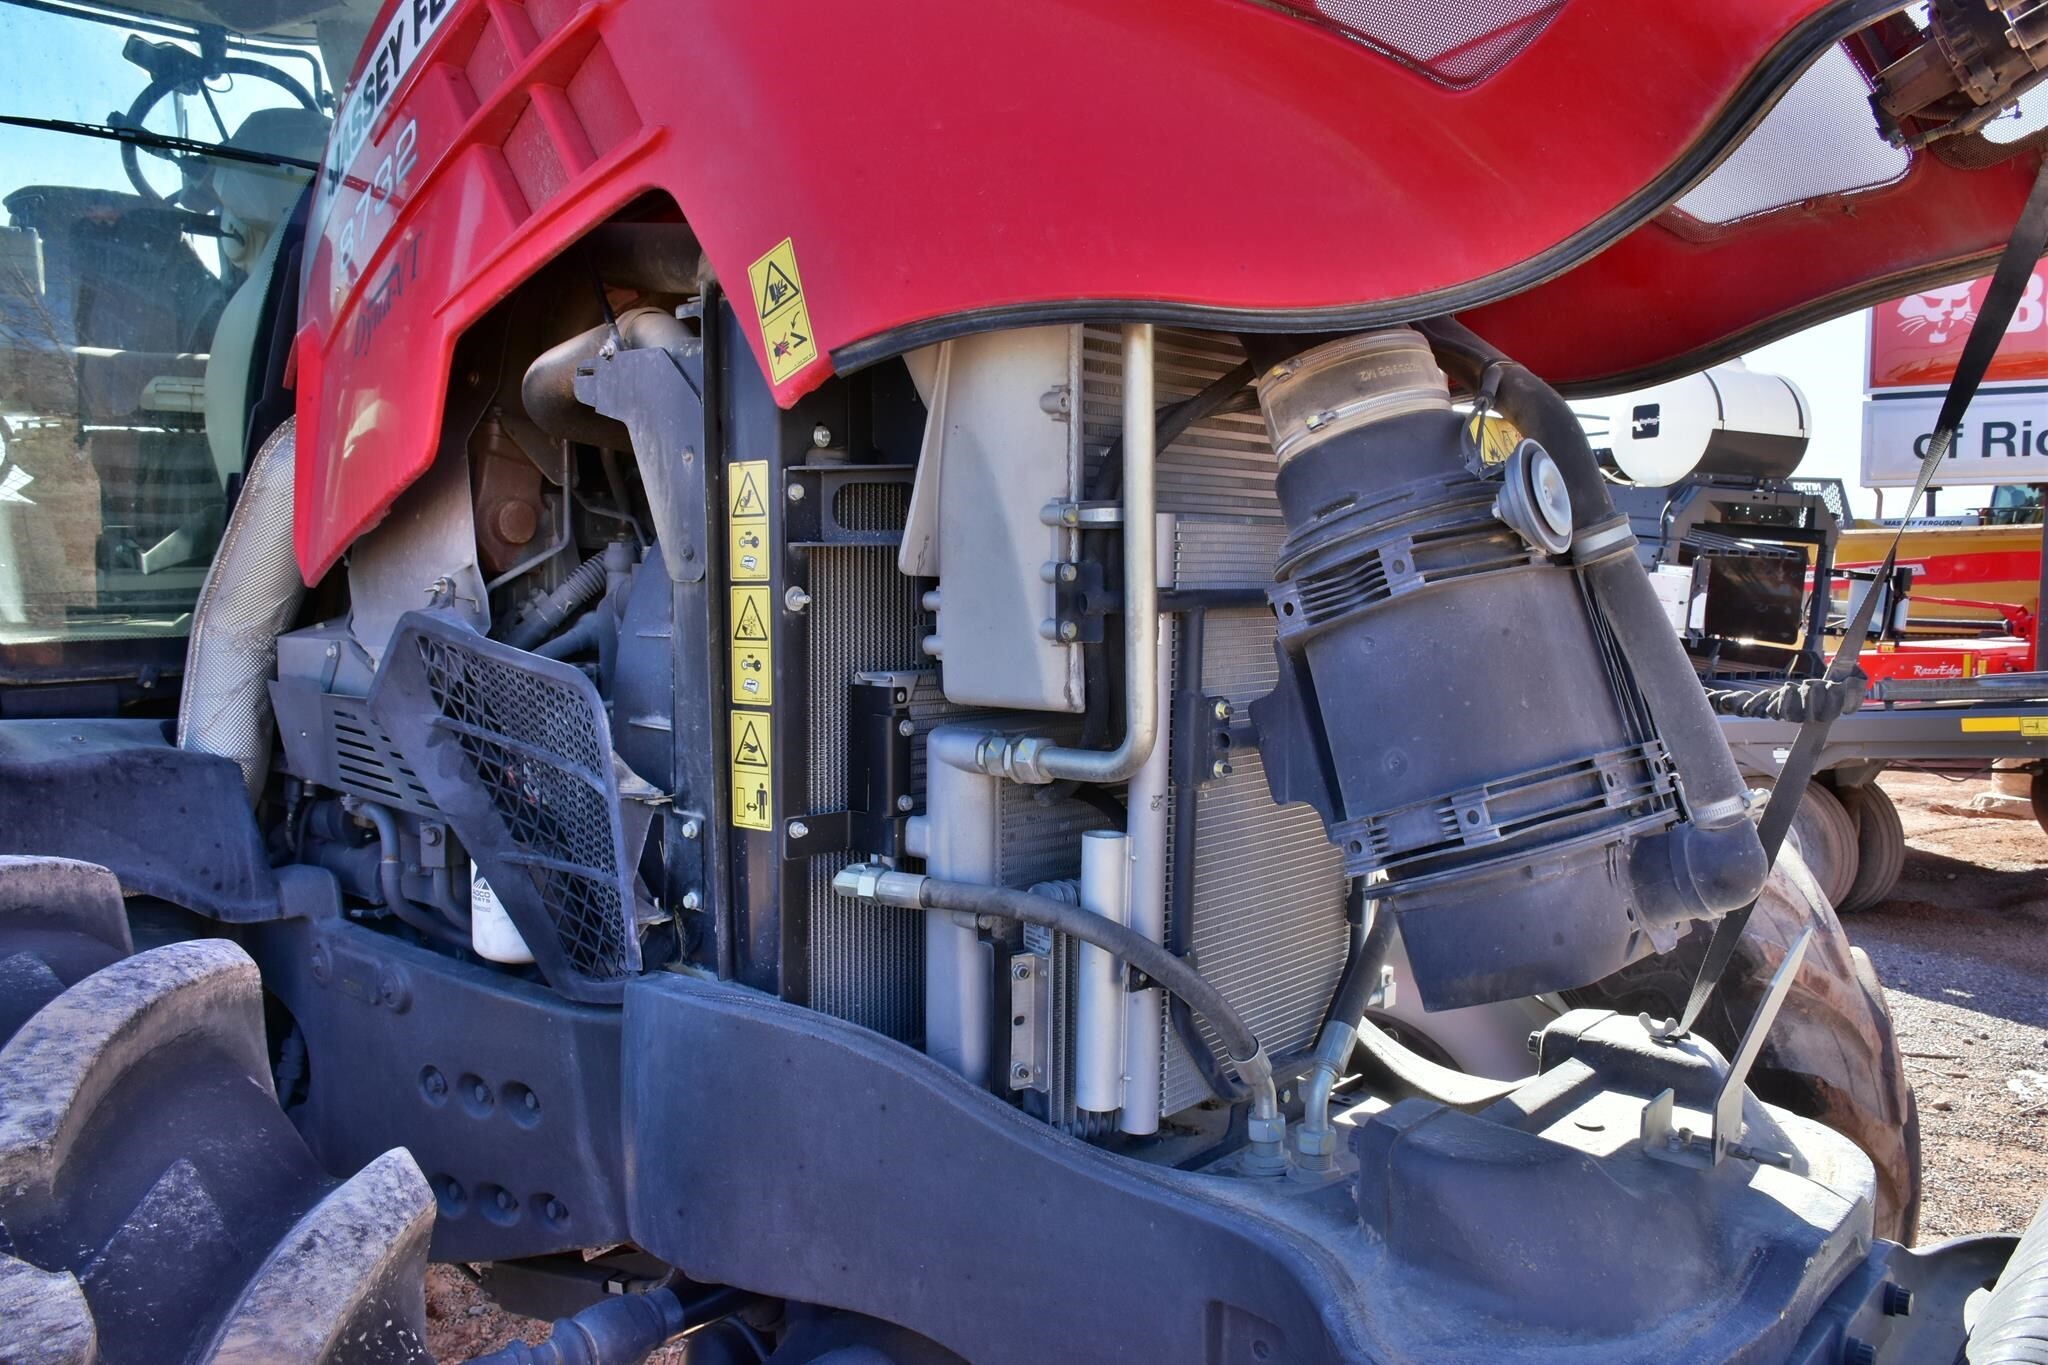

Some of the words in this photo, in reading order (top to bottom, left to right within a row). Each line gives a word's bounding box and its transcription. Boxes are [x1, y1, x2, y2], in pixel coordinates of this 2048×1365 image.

[339, 118, 418, 275] 8732
[2005, 273, 2048, 334] B
[1913, 422, 1964, 460] of
[1883, 519, 1917, 527] MASEY
[1917, 519, 1963, 527] FERGUSON
[1912, 664, 1962, 678] RazorEdge
